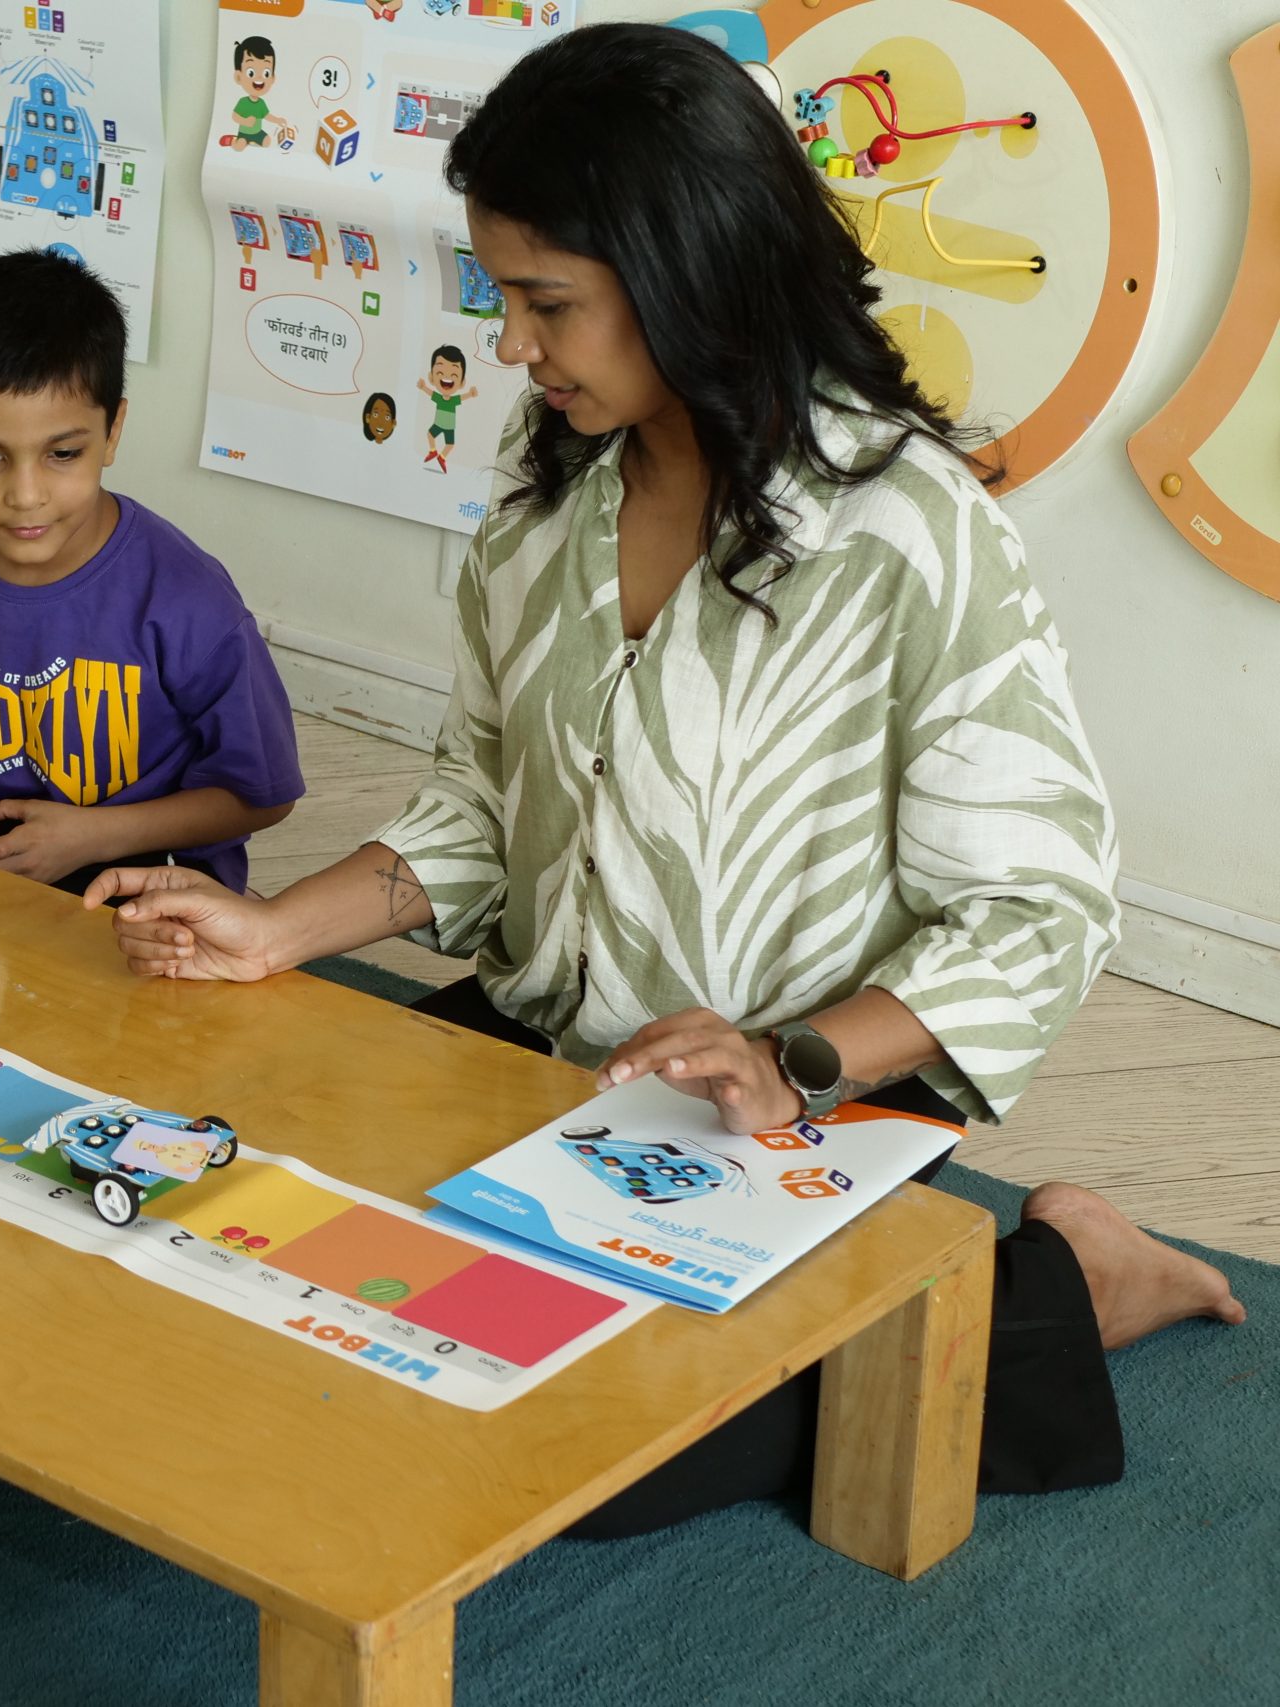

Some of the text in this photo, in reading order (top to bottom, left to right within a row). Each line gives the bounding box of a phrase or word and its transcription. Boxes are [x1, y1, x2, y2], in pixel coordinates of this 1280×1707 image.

[322, 69, 337, 87] 3!
[332, 115, 349, 128] 3
[341, 141, 354, 160] 5
[309, 325, 329, 343] तीन
[332, 332, 347, 348] (3)
[280, 341, 328, 363] बार दबाएं
[4, 672, 20, 685] OF
[24, 656, 67, 687] DREAMS
[48, 1187, 73, 1200] 3
[628, 1211, 708, 1241] पुस्तिका
[169, 1230, 195, 1247] 2
[210, 1249, 234, 1265] Two
[704, 1236, 775, 1263] शिक्षक
[597, 1238, 738, 1289] WIZBOT
[299, 1284, 322, 1300] 1
[340, 1301, 366, 1316] One
[283, 1314, 440, 1383] WIZBOT
[432, 1340, 458, 1355] 0
[477, 1355, 507, 1375] Zero
